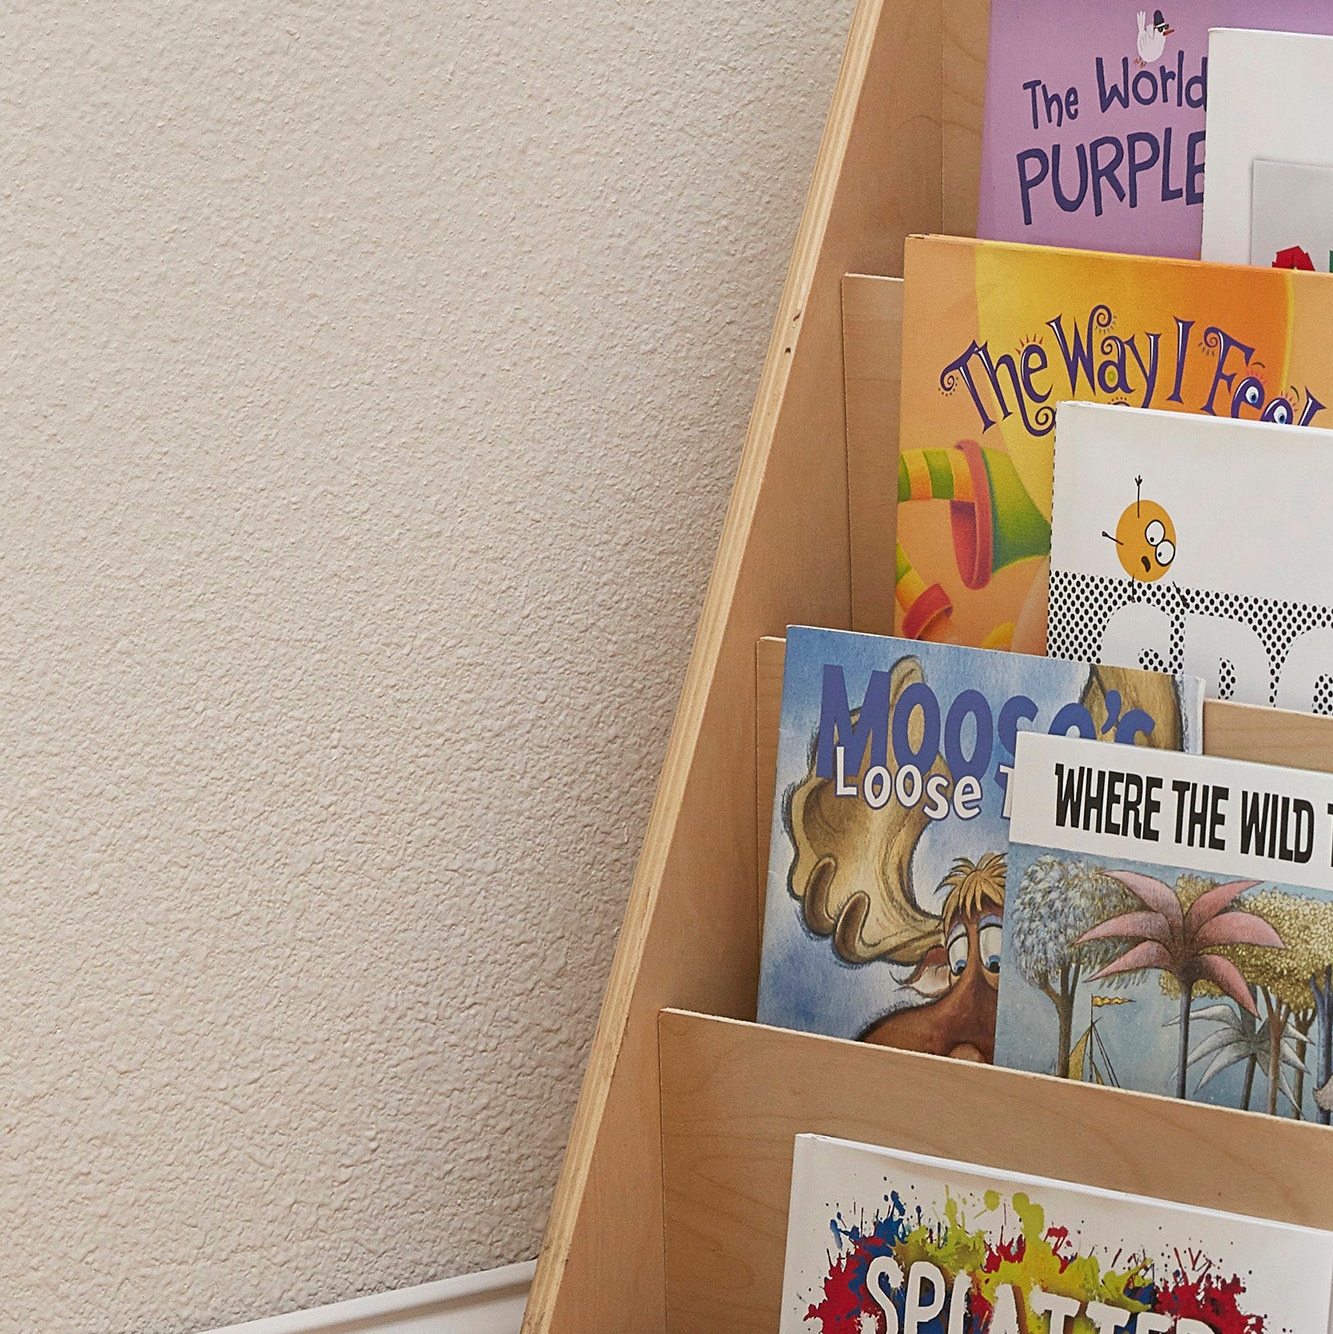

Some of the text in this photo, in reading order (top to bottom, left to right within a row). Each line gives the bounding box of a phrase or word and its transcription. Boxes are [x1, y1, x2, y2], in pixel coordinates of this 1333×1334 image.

[1022, 50, 1208, 129] The World
[1016, 127, 1207, 226] PURPLE
[939, 338, 1056, 437] The
[1045, 304, 1161, 409] Way
[1166, 316, 1195, 404] I
[835, 745, 983, 819] Loose
[1055, 763, 1163, 841] WHERE
[1172, 779, 1229, 851] THE
[1240, 790, 1315, 863] WILD
